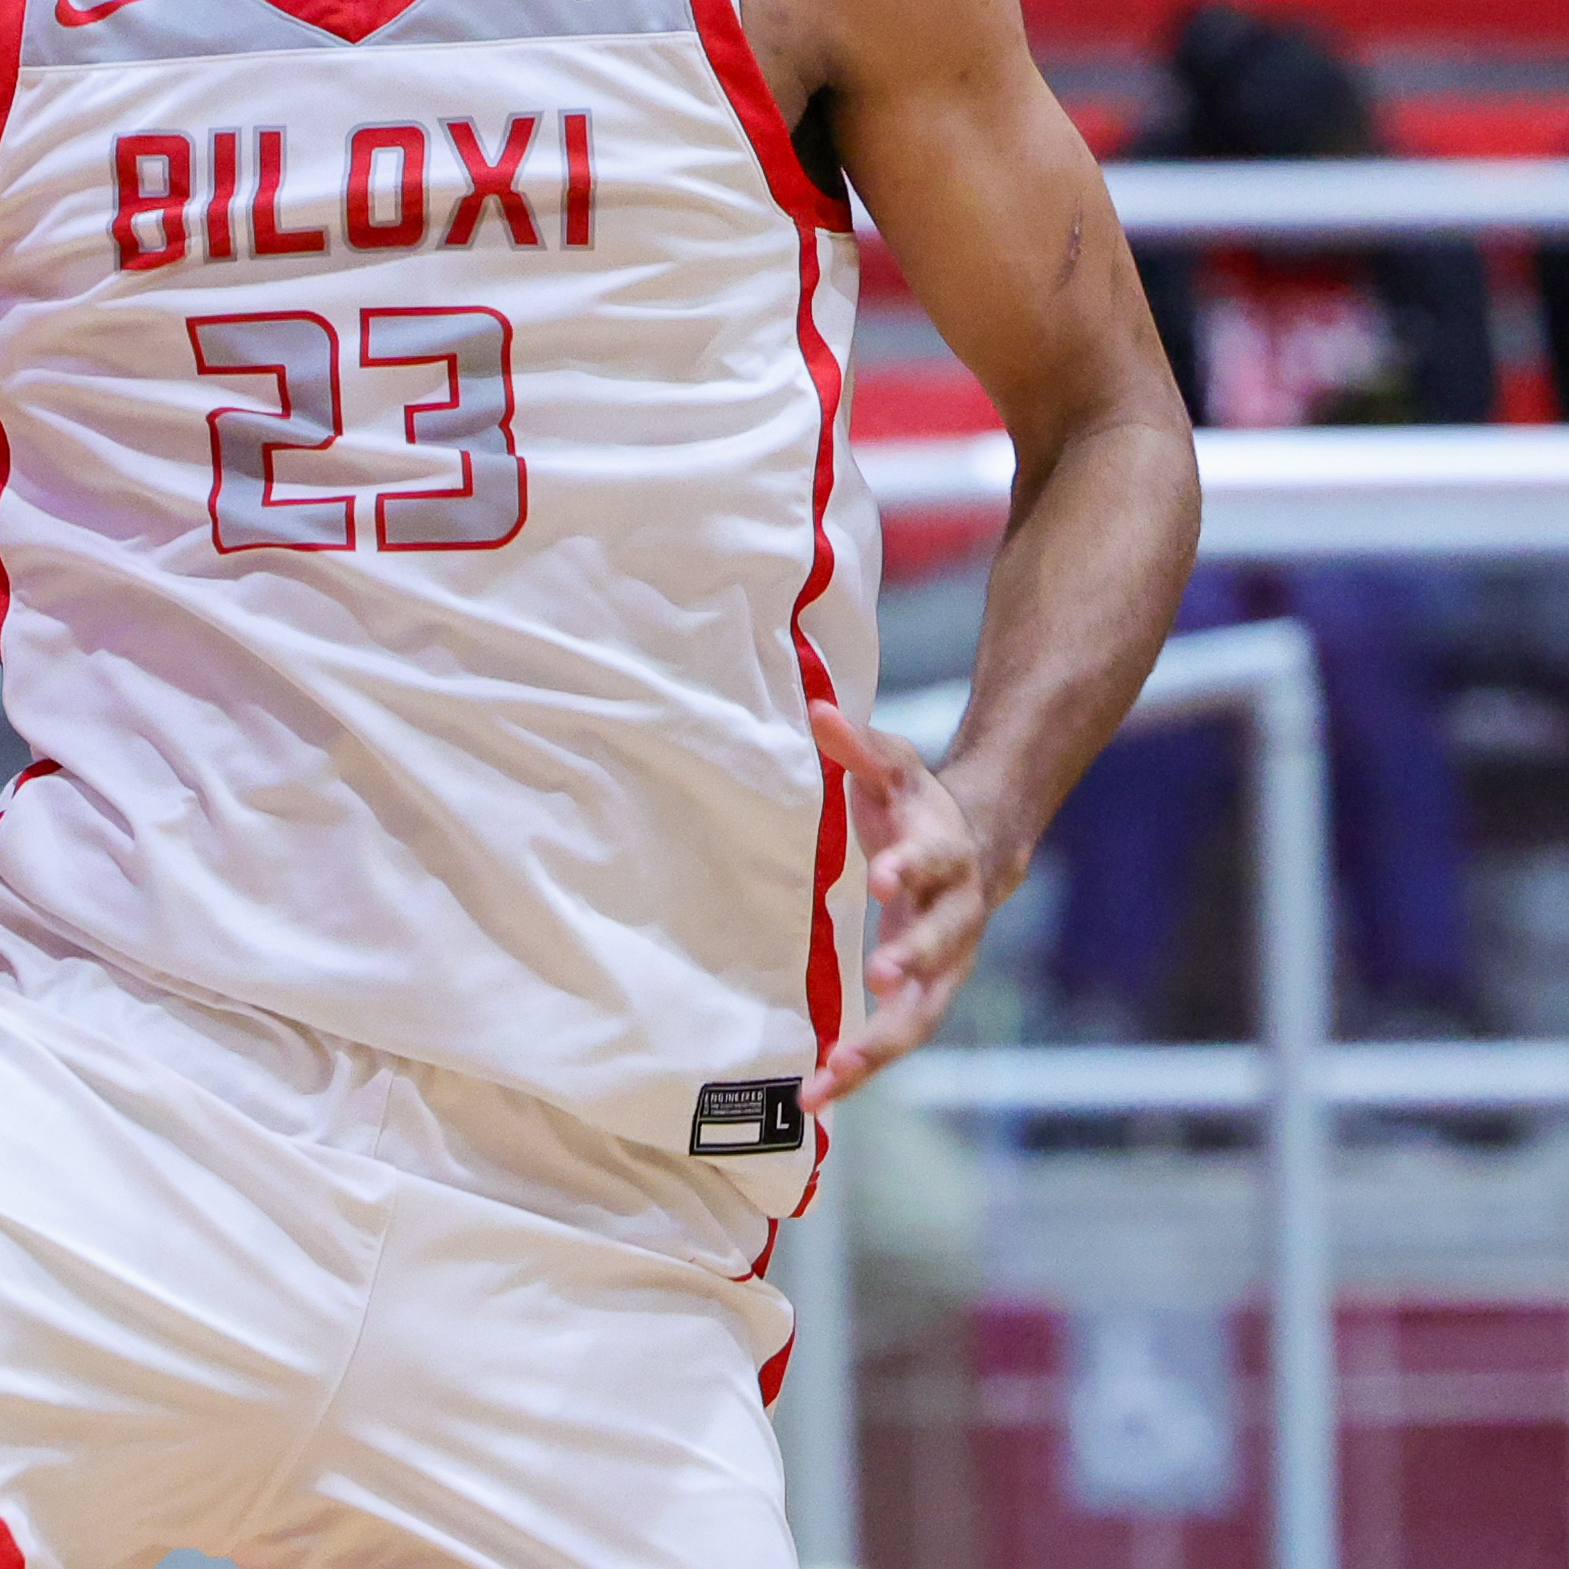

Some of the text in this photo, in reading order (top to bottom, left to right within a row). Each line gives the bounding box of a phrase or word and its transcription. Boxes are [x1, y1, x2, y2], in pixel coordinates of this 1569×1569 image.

[111, 109, 596, 271] BILOXI
[186, 306, 527, 554] 23
[776, 1101, 790, 1130] L
